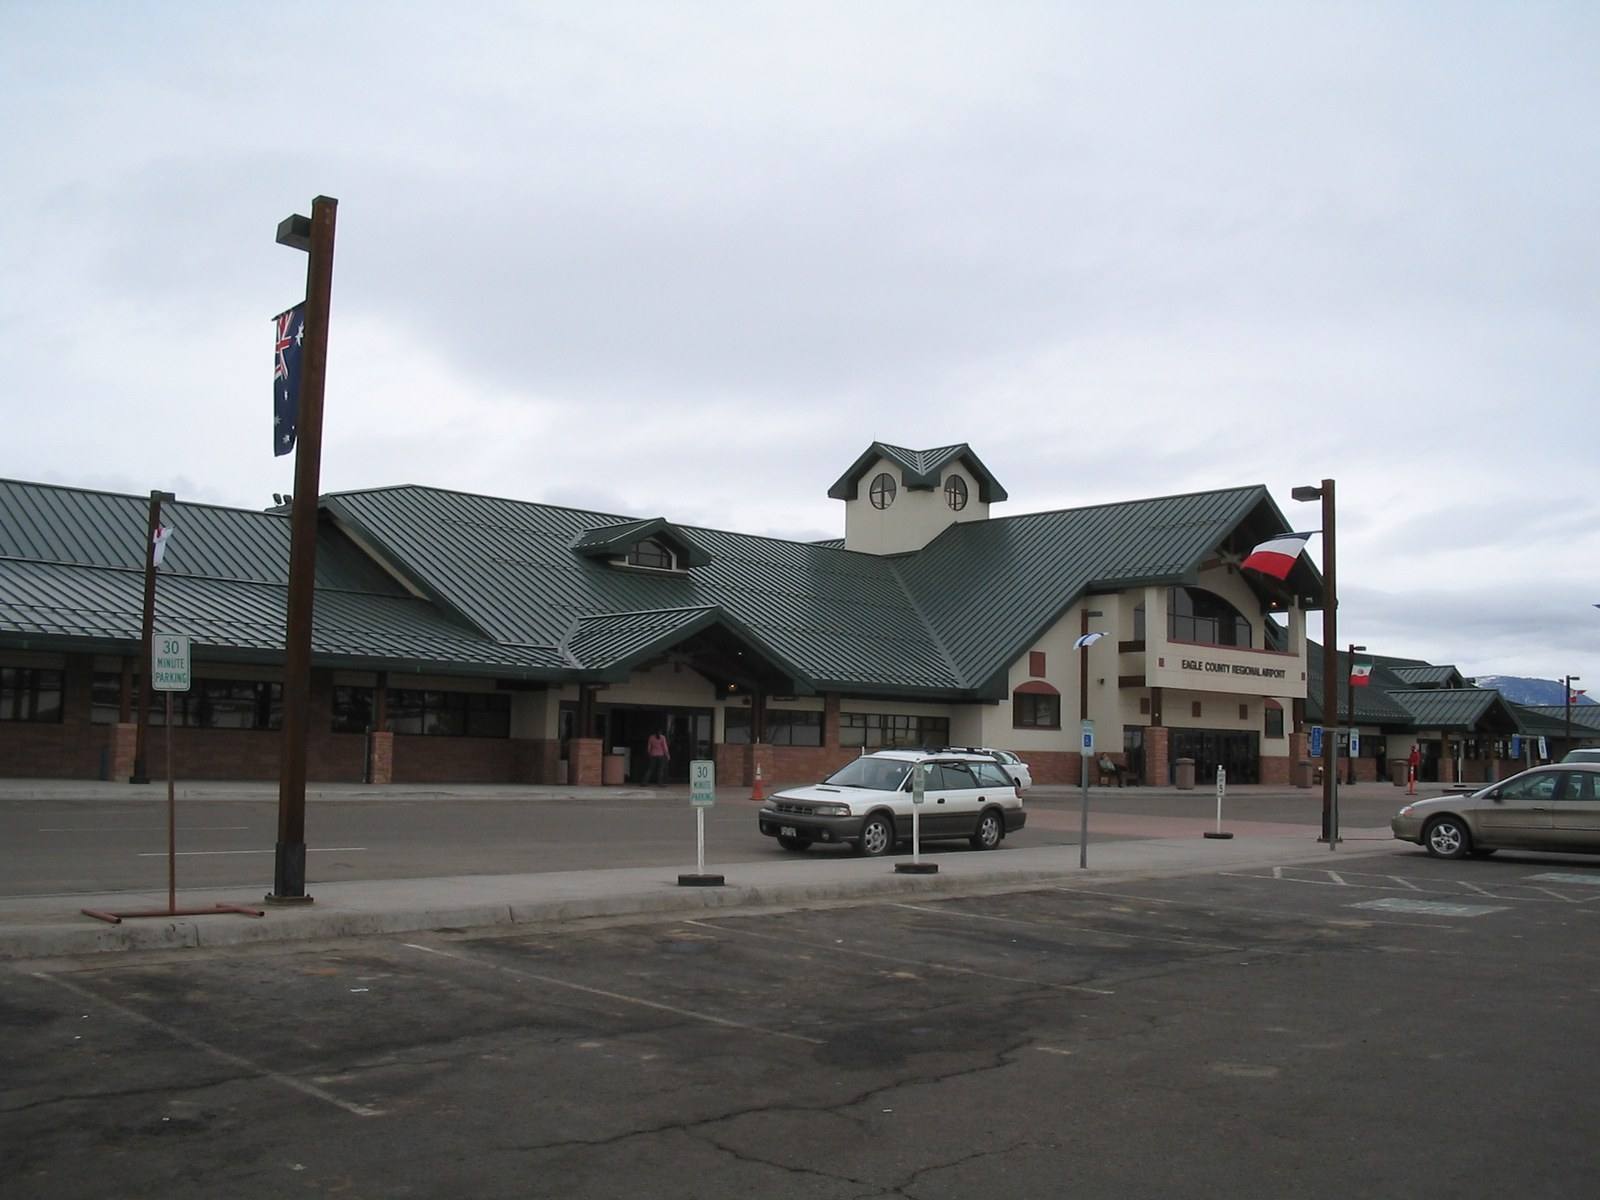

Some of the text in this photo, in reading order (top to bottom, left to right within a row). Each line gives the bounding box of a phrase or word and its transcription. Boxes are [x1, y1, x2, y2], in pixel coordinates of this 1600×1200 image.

[162, 640, 180, 655] 30
[157, 657, 185, 669] MINUTE
[1181, 659, 1286, 679] EAGLE COUNTY REGIONAL AIRPORT
[155, 672, 187, 684] PARKING
[697, 766, 708, 778] 30
